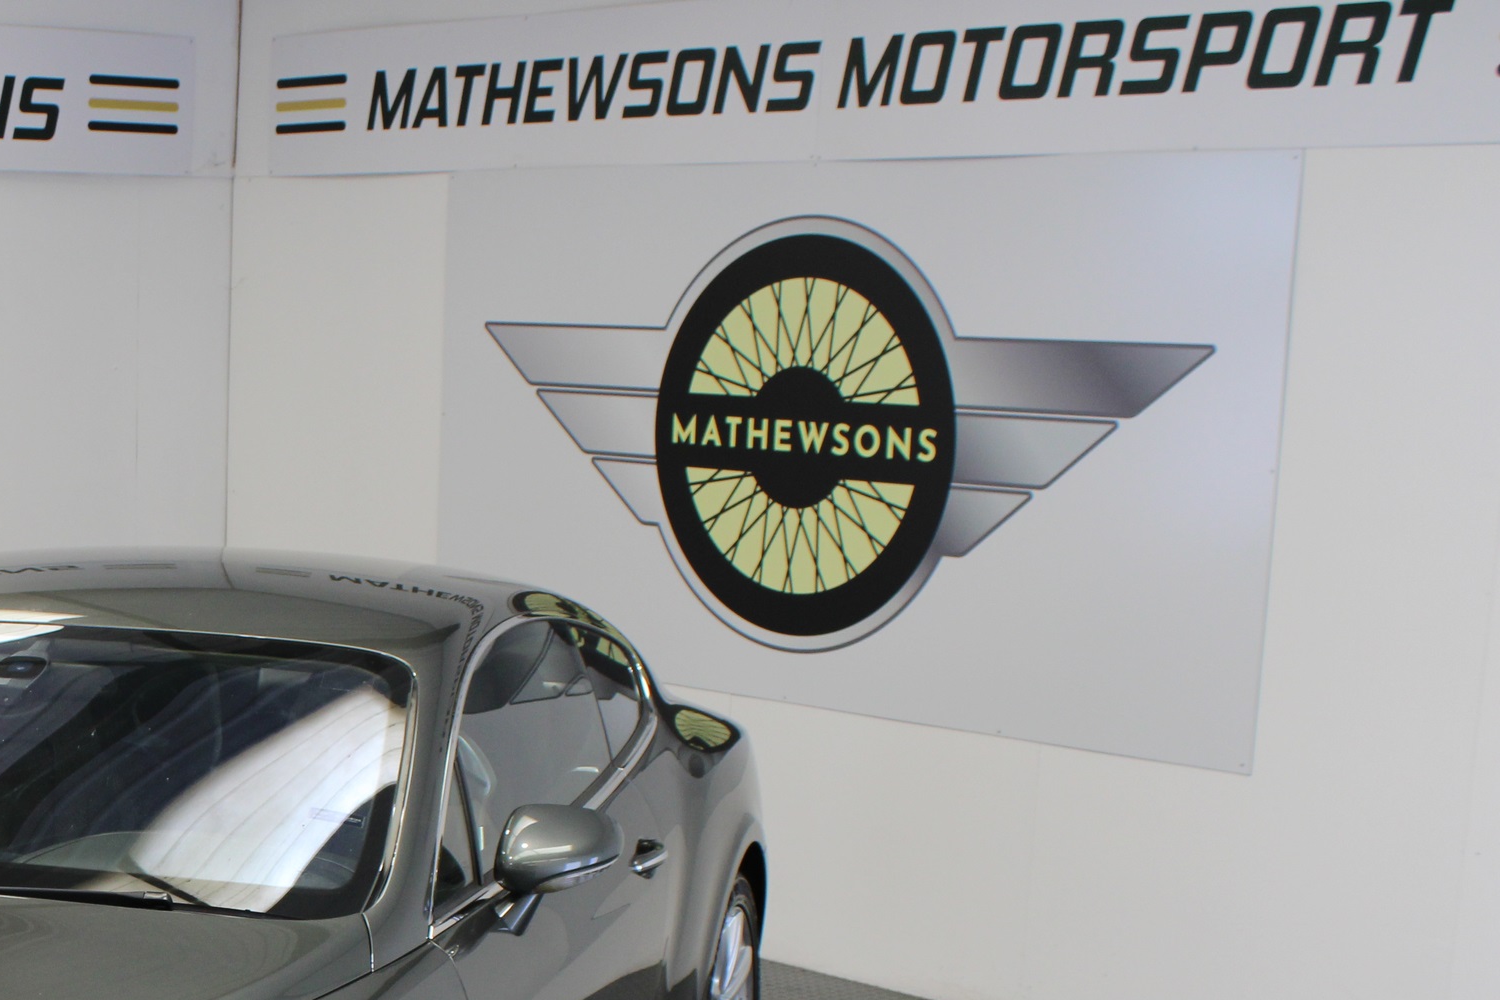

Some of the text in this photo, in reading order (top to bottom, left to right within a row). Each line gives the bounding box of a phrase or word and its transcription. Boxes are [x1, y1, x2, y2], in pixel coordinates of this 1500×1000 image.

[366, 0, 1456, 131] MATHEWSONS MOTORSPORT
[671, 412, 938, 463] MATHEWSONS
